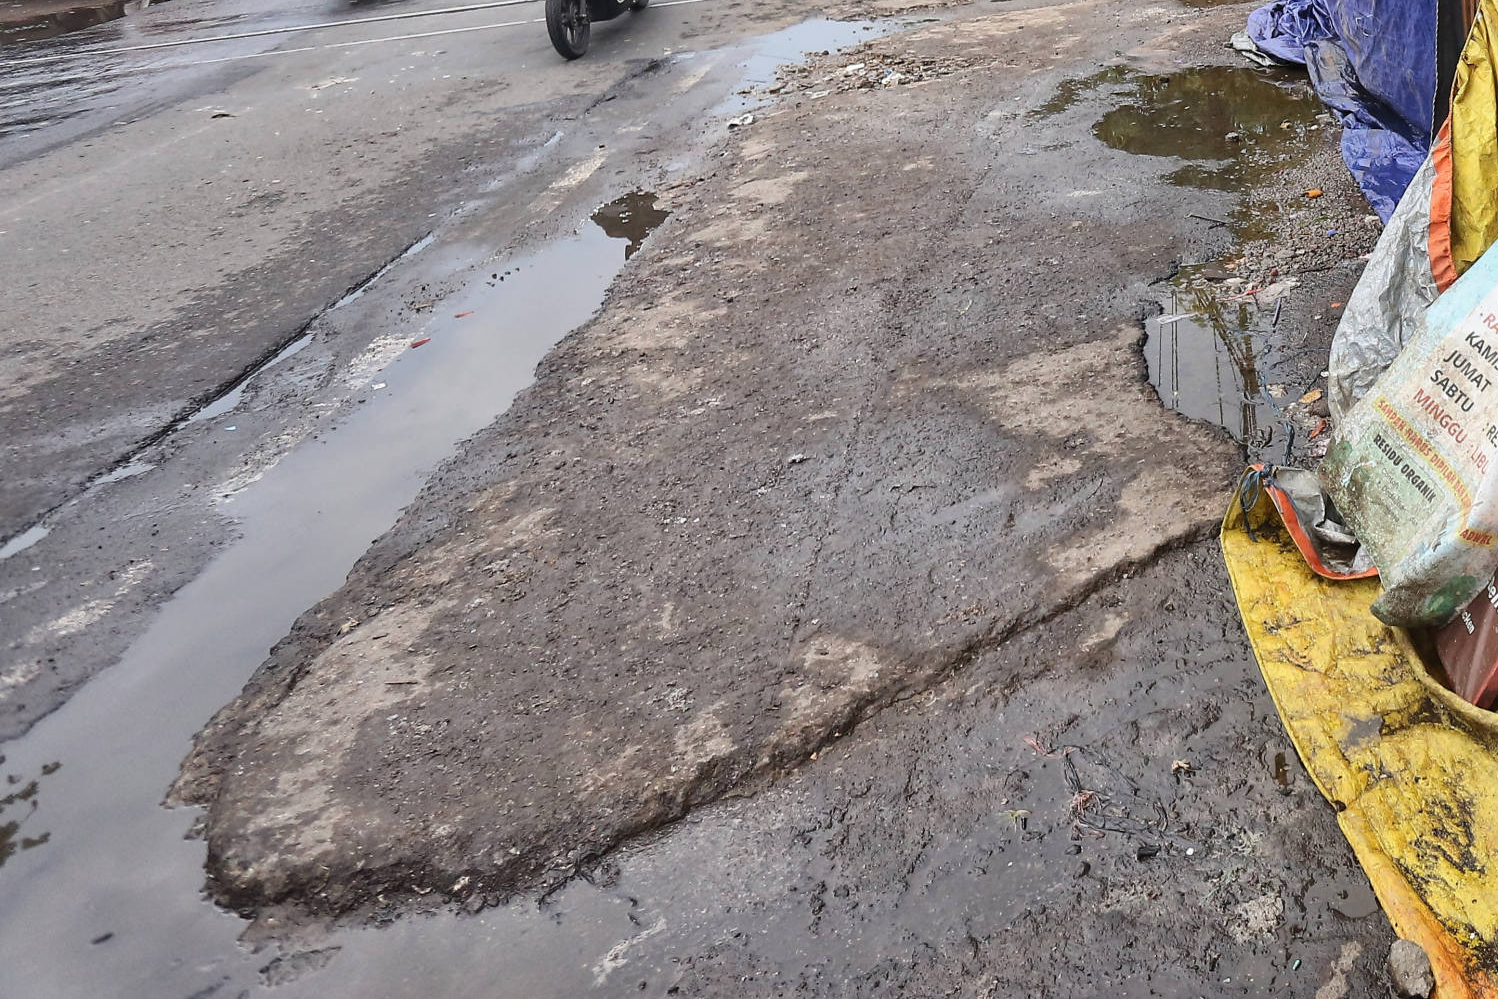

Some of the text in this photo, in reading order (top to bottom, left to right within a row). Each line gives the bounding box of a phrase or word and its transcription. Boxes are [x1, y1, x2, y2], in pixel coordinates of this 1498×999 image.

[1430, 368, 1475, 413] SABTU
[1443, 350, 1492, 393] JUMAT
[1377, 399, 1405, 432] SAMPAH
[1405, 427, 1432, 458] HARUS
[1413, 388, 1468, 444] MINGGU
[1372, 433, 1402, 467] RESIDU
[1400, 464, 1437, 503] ORGANIK
[1460, 529, 1493, 545] ADWAL
